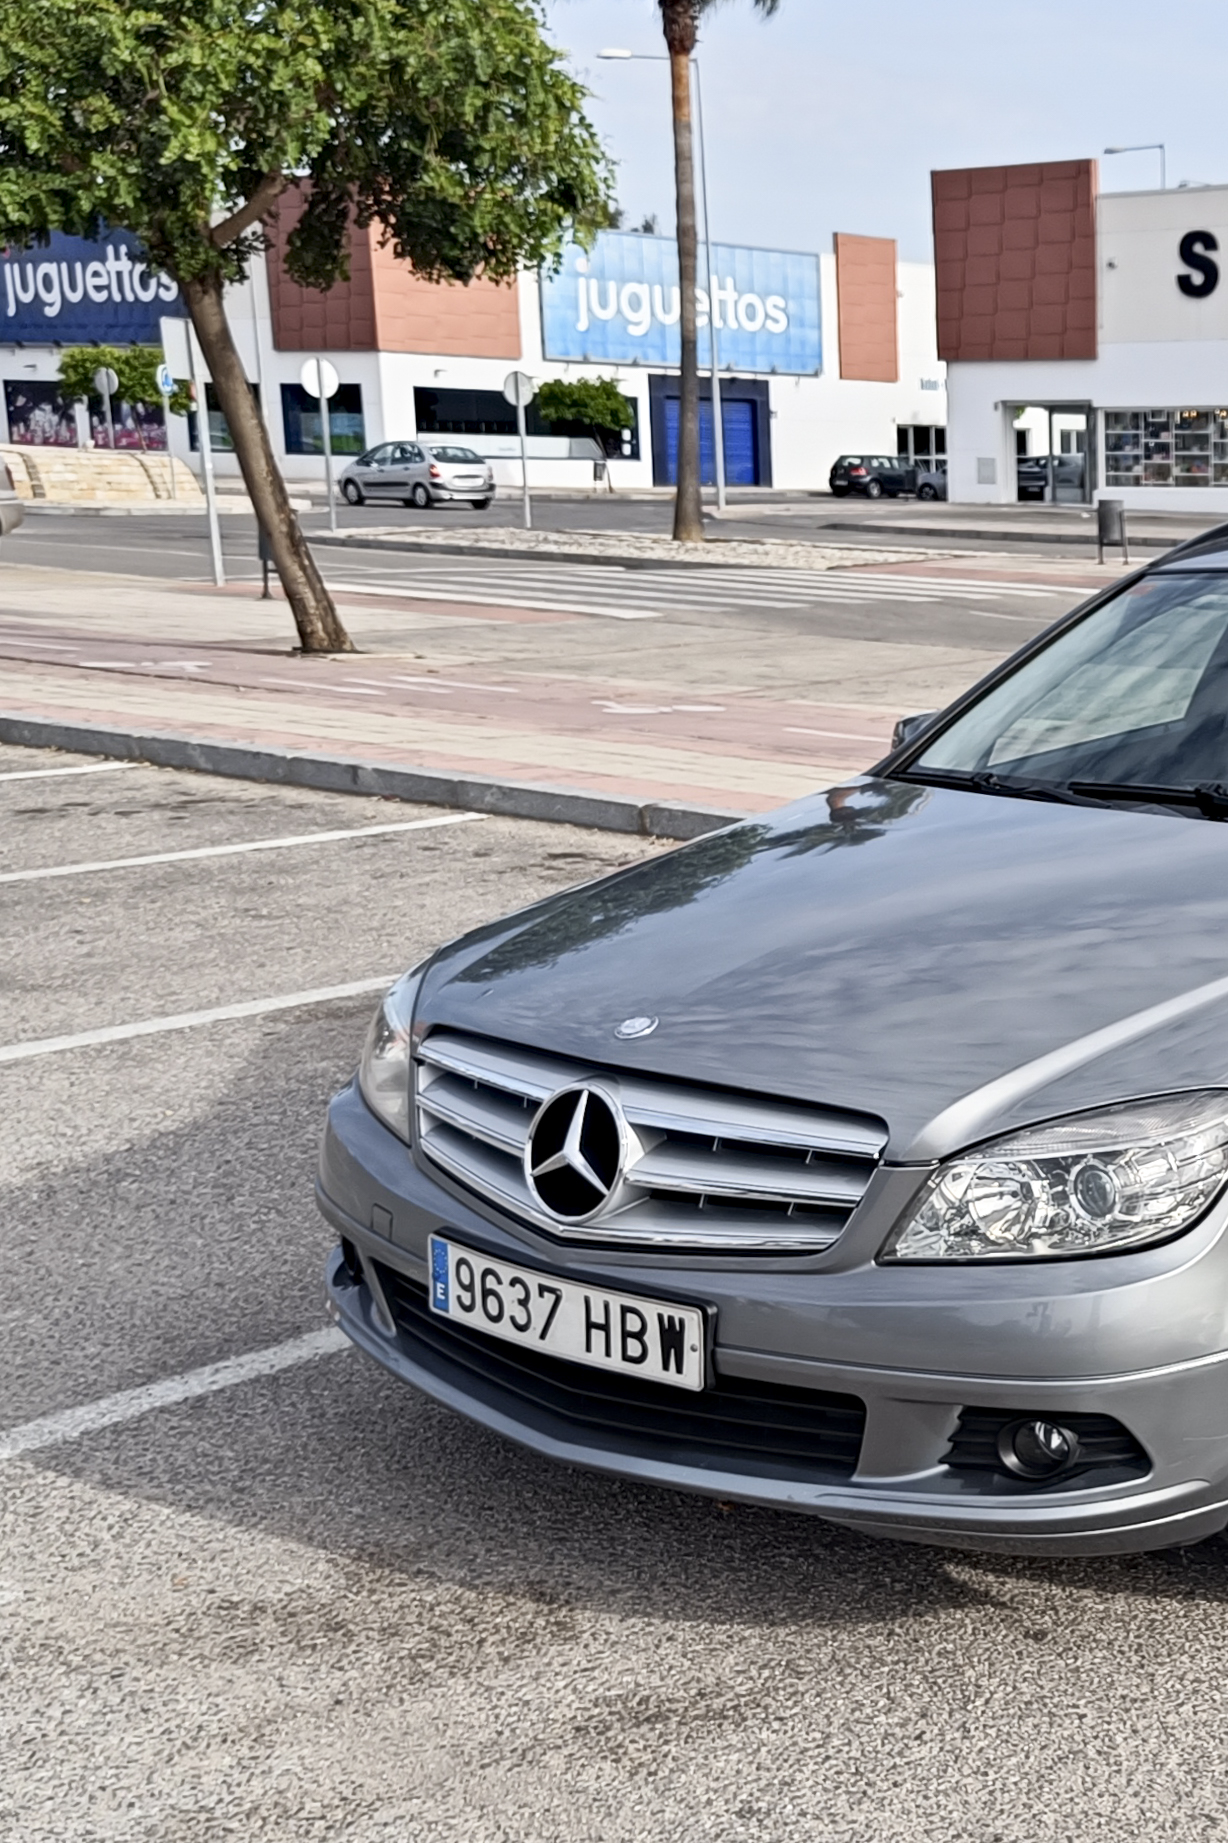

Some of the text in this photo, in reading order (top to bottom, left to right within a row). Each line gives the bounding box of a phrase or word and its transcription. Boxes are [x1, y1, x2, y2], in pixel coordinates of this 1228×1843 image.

[4, 243, 179, 317] juguettos
[436, 1282, 446, 1300] E
[455, 1257, 686, 1375] 9637 HBW
